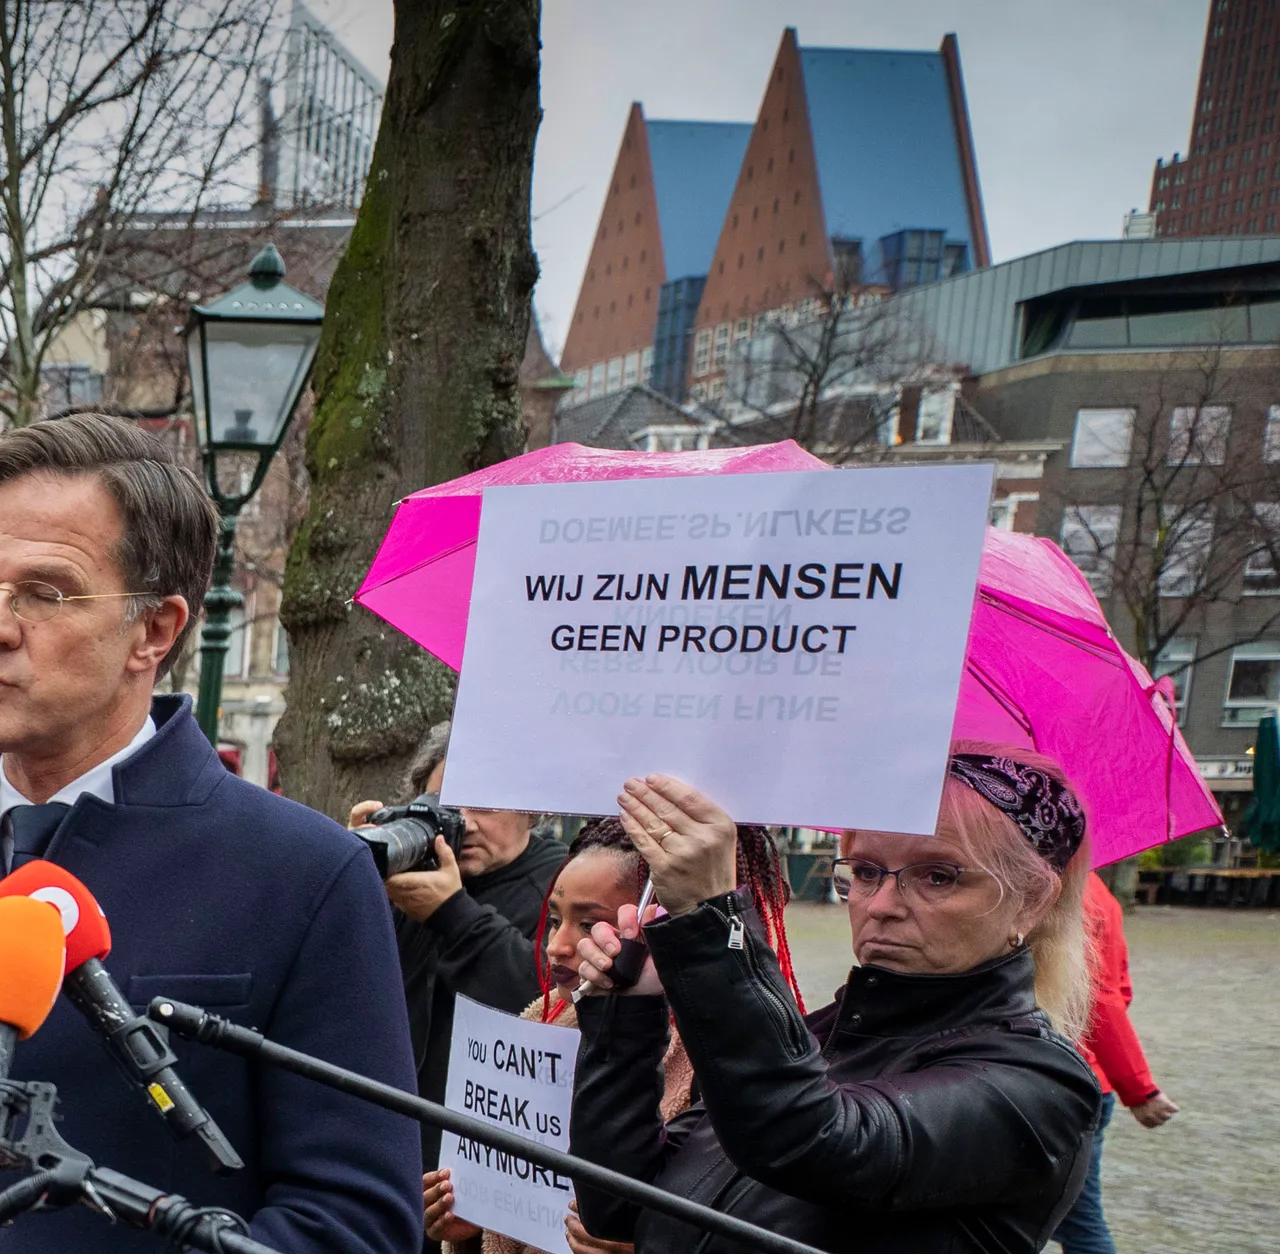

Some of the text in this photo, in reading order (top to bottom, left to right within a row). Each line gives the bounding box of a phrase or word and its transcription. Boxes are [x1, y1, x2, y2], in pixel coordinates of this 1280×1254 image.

[525, 562, 904, 602] WIJ ZIJN MENSEN
[550, 624, 857, 654] GEEN PRODUCT
[467, 1037, 487, 1064] YOU
[464, 1079, 531, 1131] BREAK
[536, 1112, 562, 1137] US
